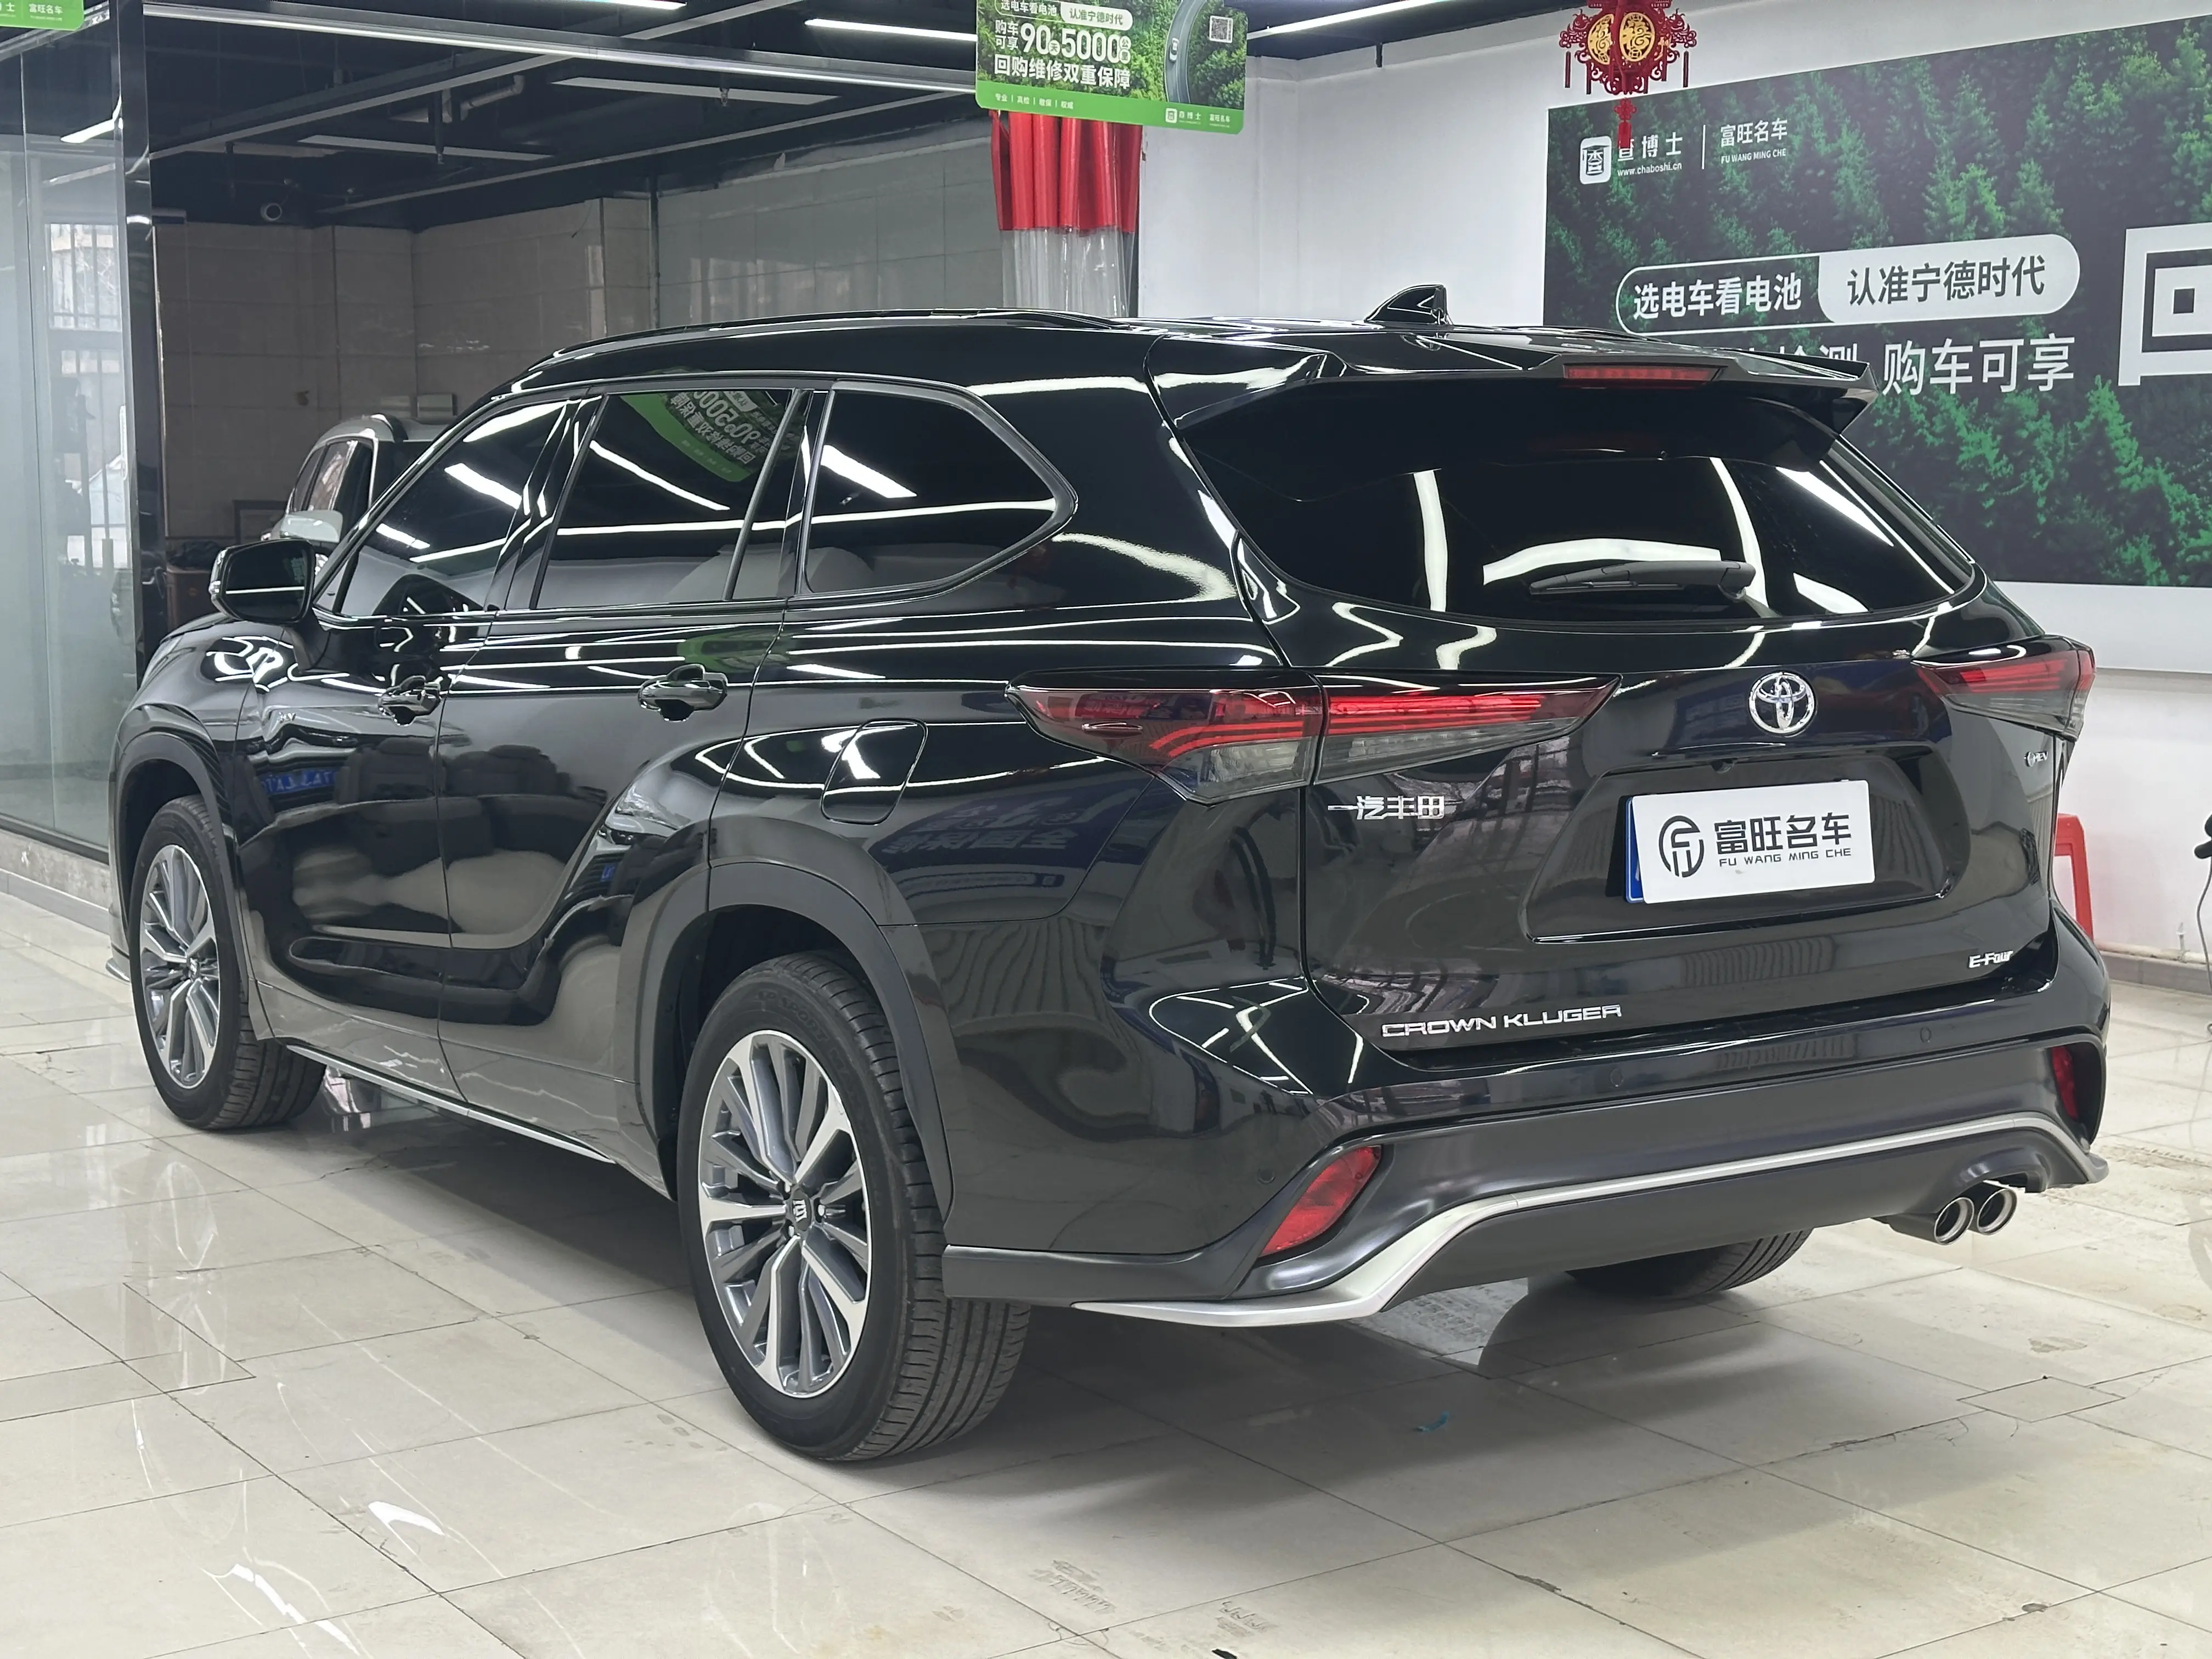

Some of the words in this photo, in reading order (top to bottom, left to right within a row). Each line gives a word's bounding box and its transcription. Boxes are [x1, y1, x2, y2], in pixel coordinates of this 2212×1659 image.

[1001, 0, 1057, 16] 选电车看电池
[1069, 8, 1124, 25] 认准宁德时代
[995, 20, 1019, 35] 购车
[995, 35, 1019, 50] 可享
[994, 54, 1131, 89] 回购维修双重保障
[1720, 117, 1788, 148] 富旺名车
[1721, 156, 1730, 164] FU
[1731, 153, 1752, 162] WANG
[1753, 150, 1771, 160] MING
[1773, 148, 1786, 157] CHE
[1617, 162, 1683, 177] www.chaboshi.cn
[1847, 255, 2045, 307] 认准宁德时代
[1633, 273, 1802, 320] 选电车看电池
[1882, 332, 2075, 395] 购车可享
[1328, 795, 1444, 820] 一汽丰田
[1714, 812, 1852, 855] 富旺名车
[1719, 857, 1737, 867] FU
[1744, 854, 1782, 864] WANG
[1788, 851, 1819, 861] MING
[1826, 848, 1852, 858] CHE
[1968, 950, 2014, 968] E-Four
[1382, 1017, 1497, 1037] CROWN
[1504, 1004, 1622, 1028] KLUGER
